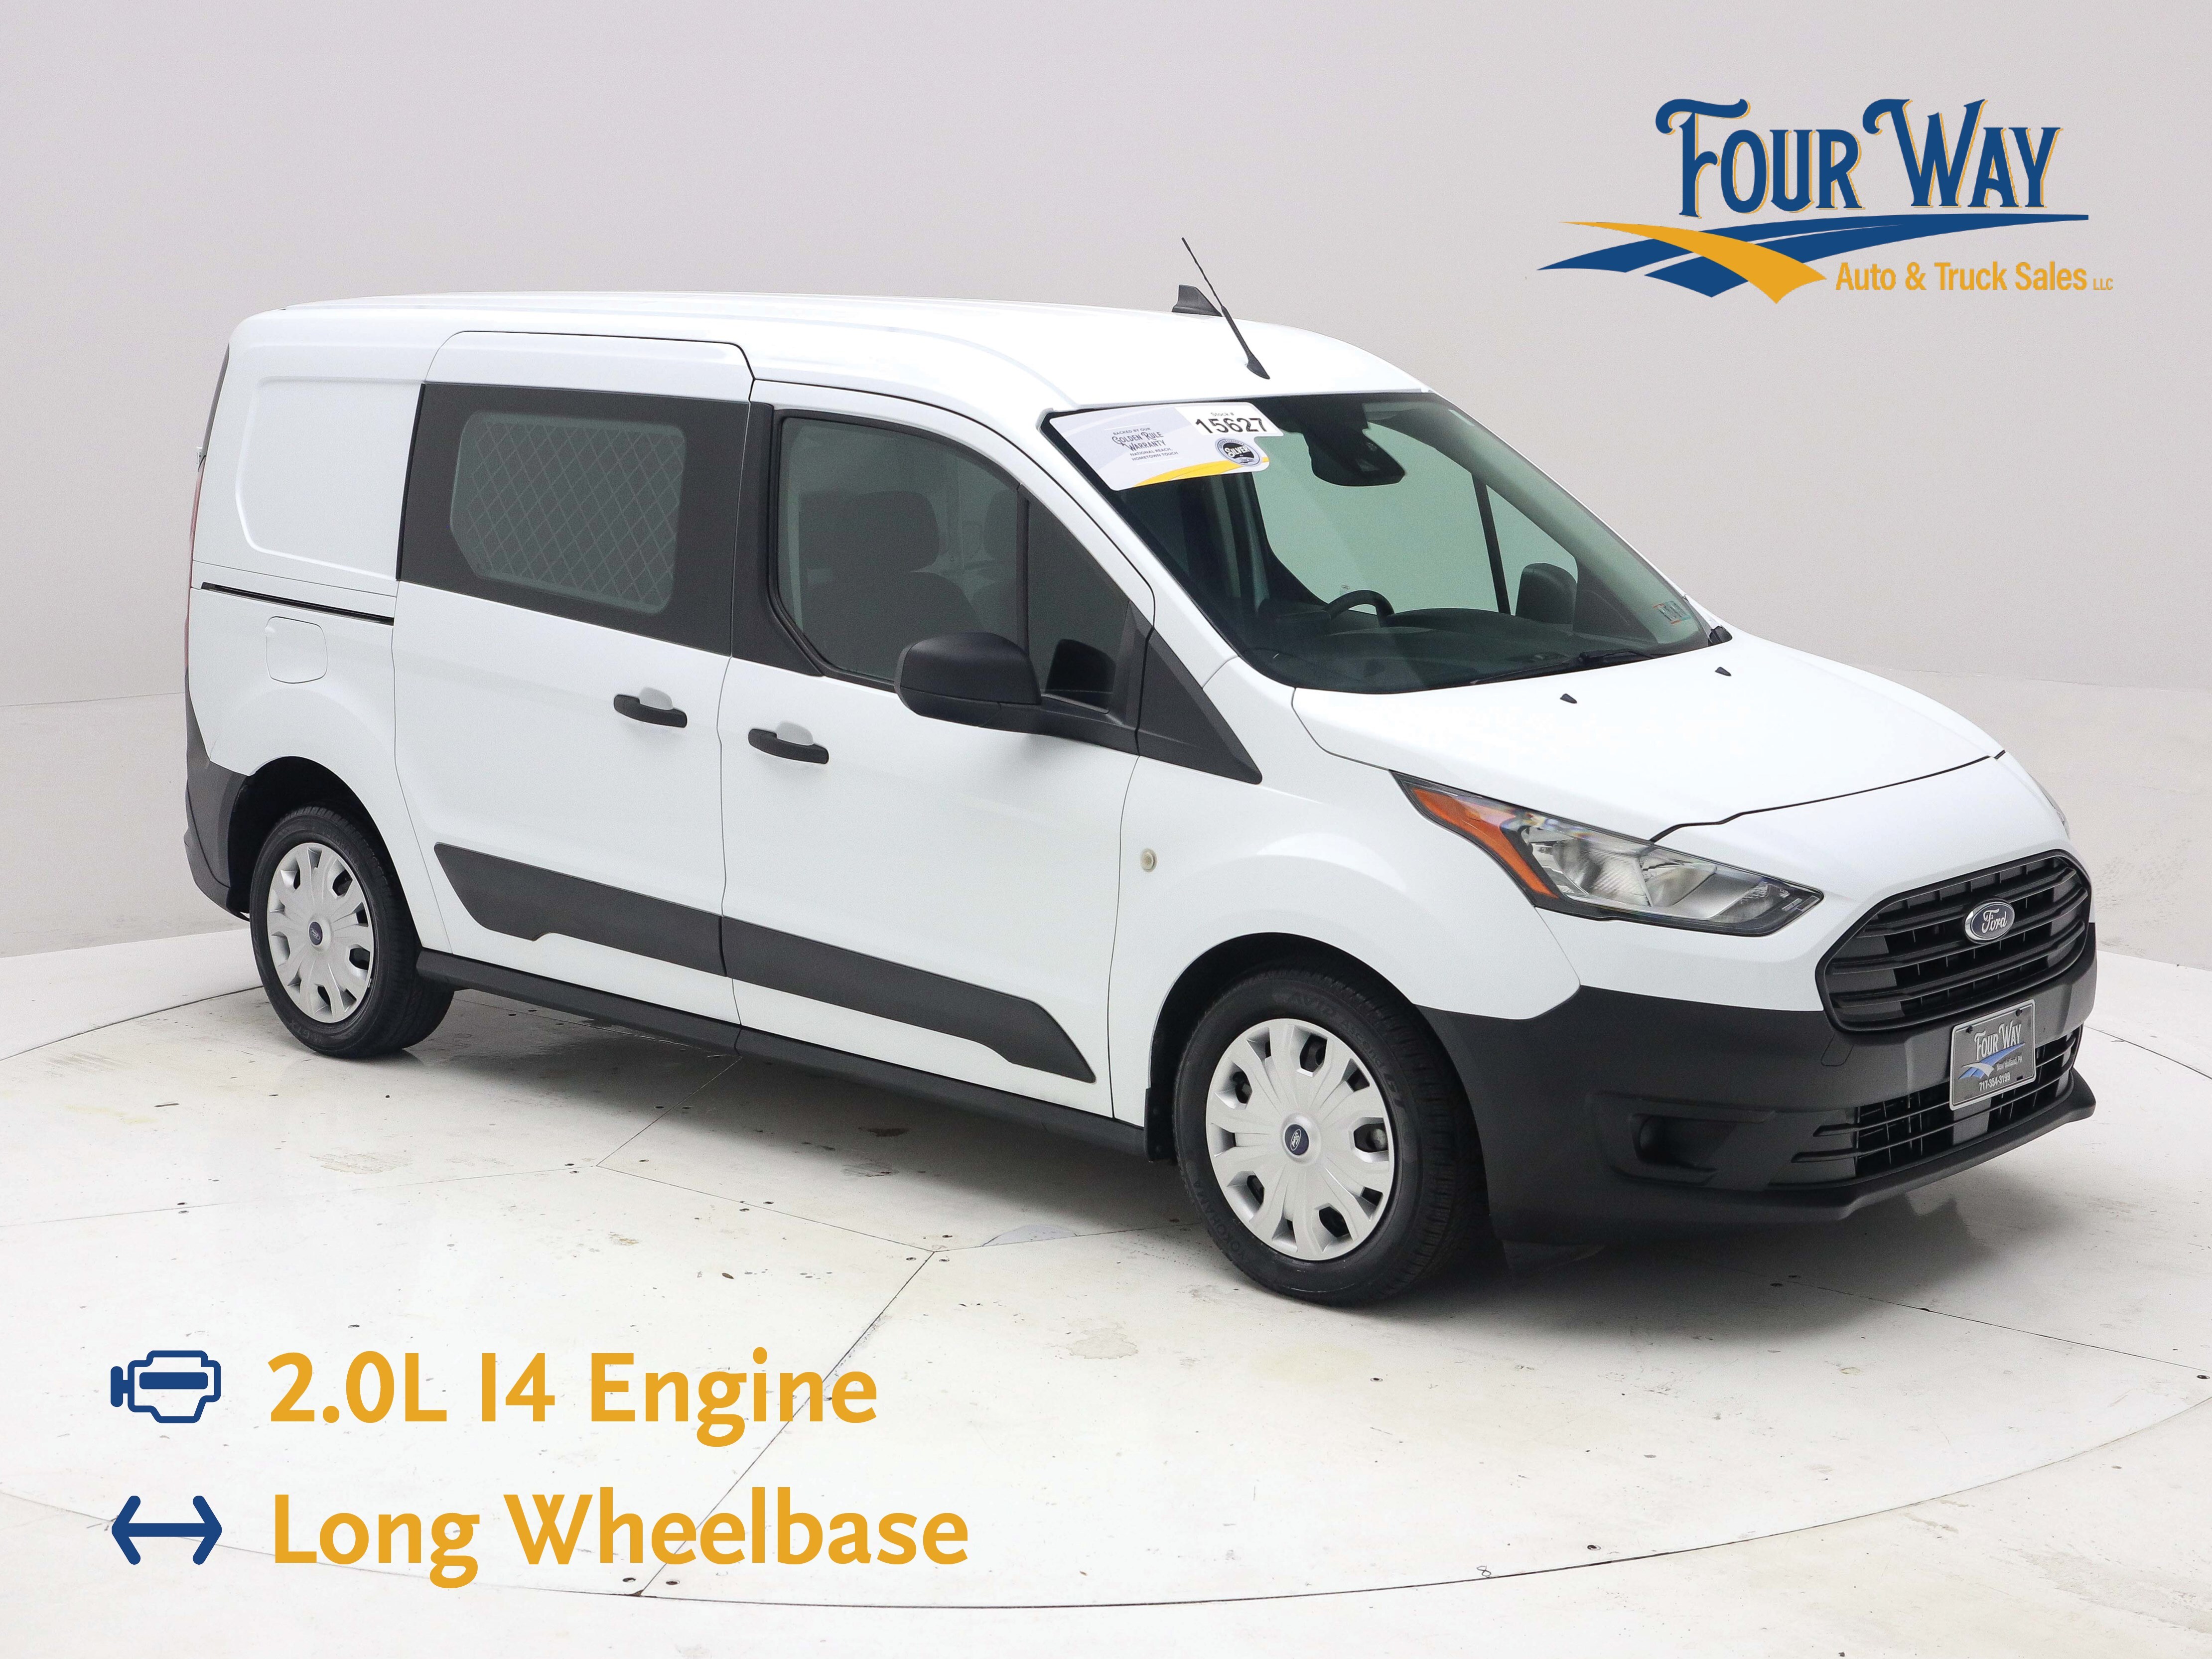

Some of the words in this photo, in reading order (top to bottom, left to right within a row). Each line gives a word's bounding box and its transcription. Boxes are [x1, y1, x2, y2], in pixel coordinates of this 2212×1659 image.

[1196, 418, 1267, 433] 15627
[1122, 440, 1166, 451] WARRANTY
[1225, 446, 1250, 457] SILVER
[1981, 908, 2007, 933] Ford
